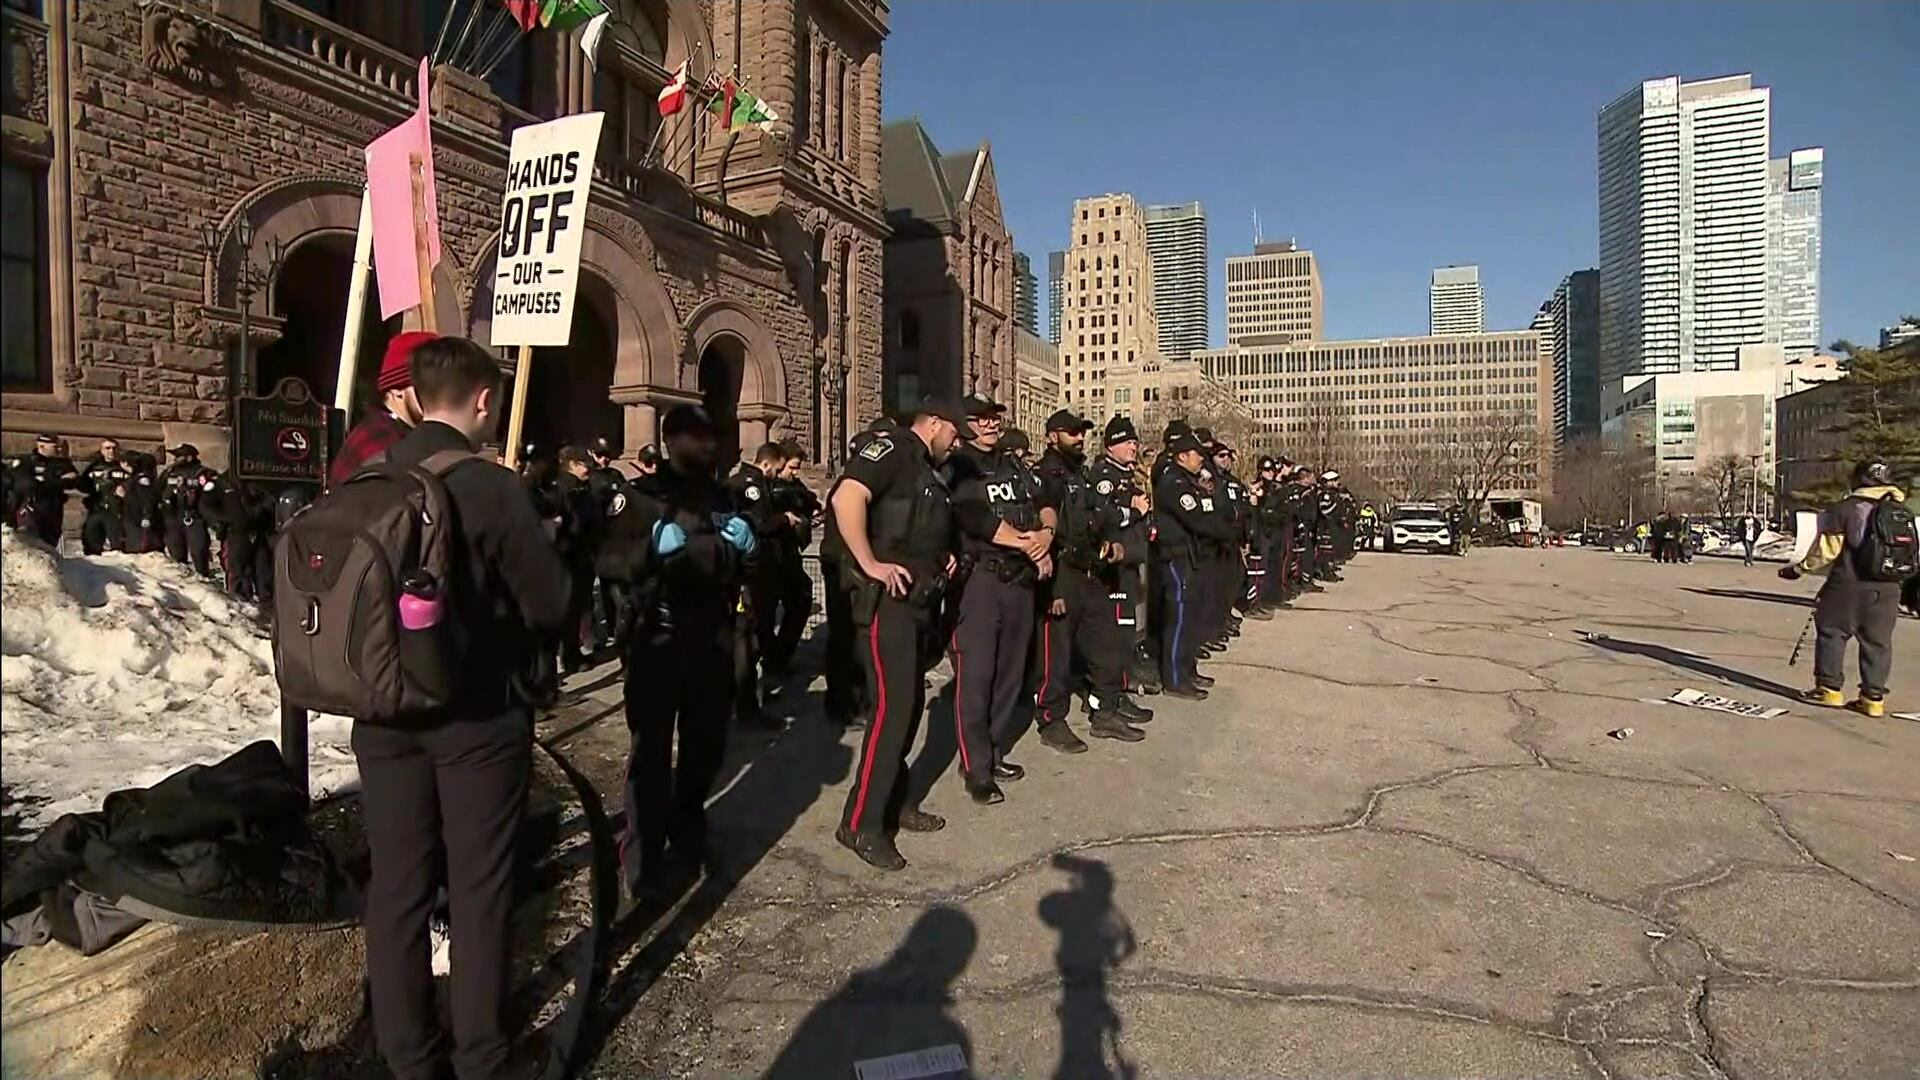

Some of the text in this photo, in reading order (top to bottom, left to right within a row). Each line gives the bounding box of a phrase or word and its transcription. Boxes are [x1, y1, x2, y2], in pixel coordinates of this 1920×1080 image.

[507, 151, 580, 193] HANDS
[501, 190, 574, 258] OFF
[513, 261, 543, 286] OUR
[495, 291, 562, 315] CAMPUSES
[986, 481, 1017, 503] POL
